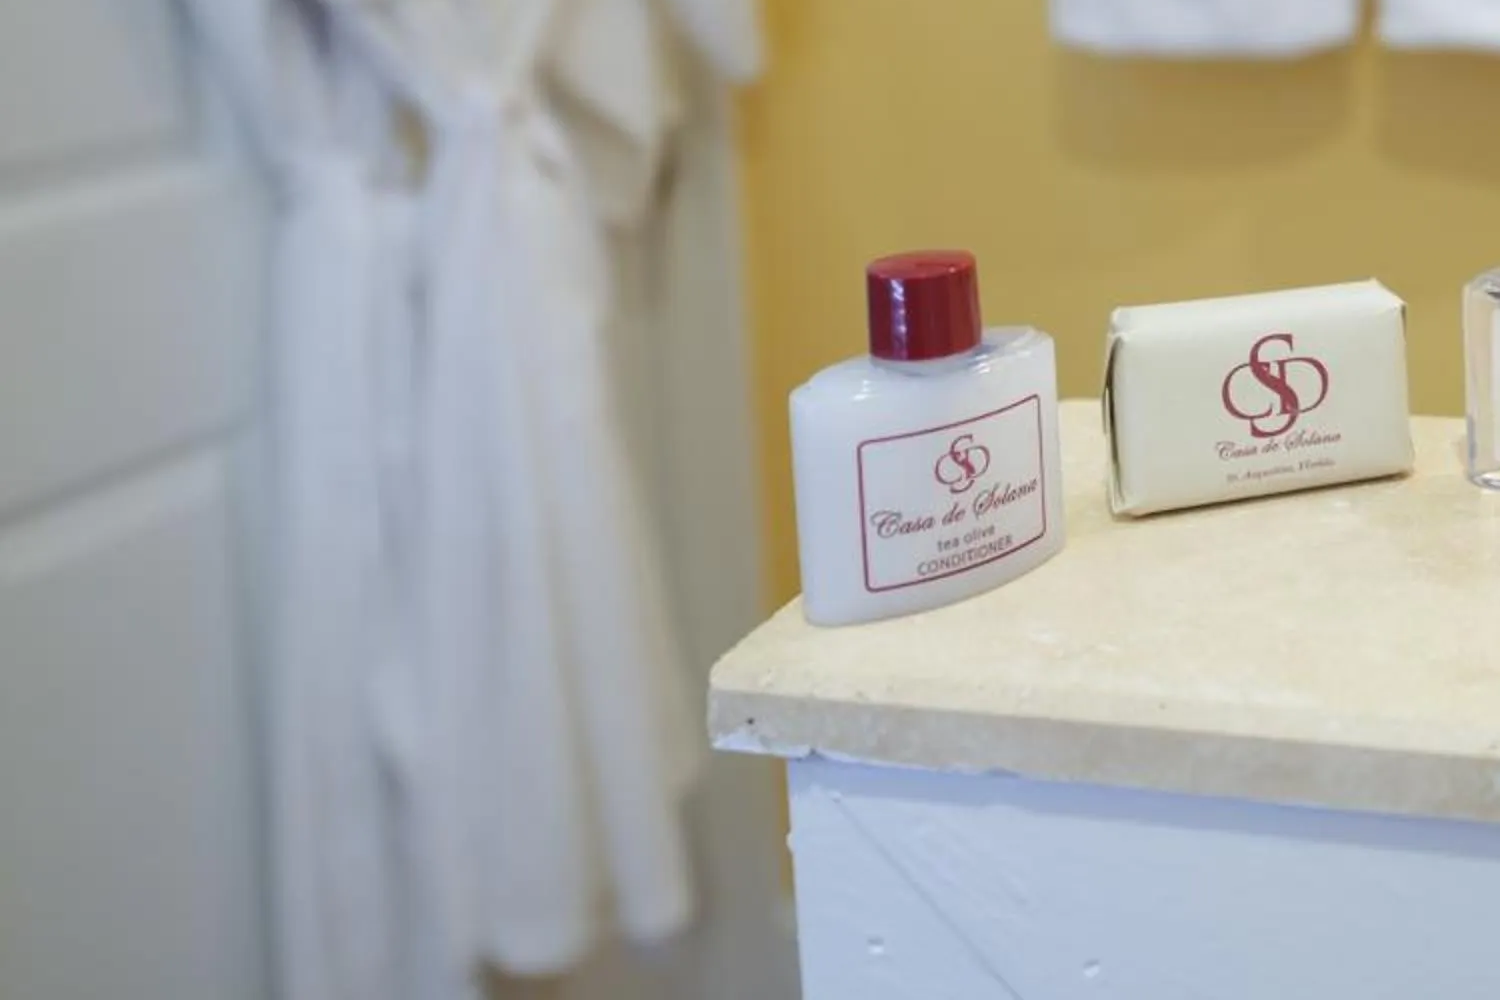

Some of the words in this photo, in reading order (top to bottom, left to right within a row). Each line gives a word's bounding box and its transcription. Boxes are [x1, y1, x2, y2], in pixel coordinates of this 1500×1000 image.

[1215, 439, 1257, 461] Casa
[1261, 438, 1280, 455] de
[870, 510, 935, 540] Casa
[941, 502, 967, 527] de
[973, 478, 1038, 521] Solana
[916, 534, 1014, 577] CONDITIONER
[937, 536, 961, 553] tea
[963, 525, 996, 545] olive
